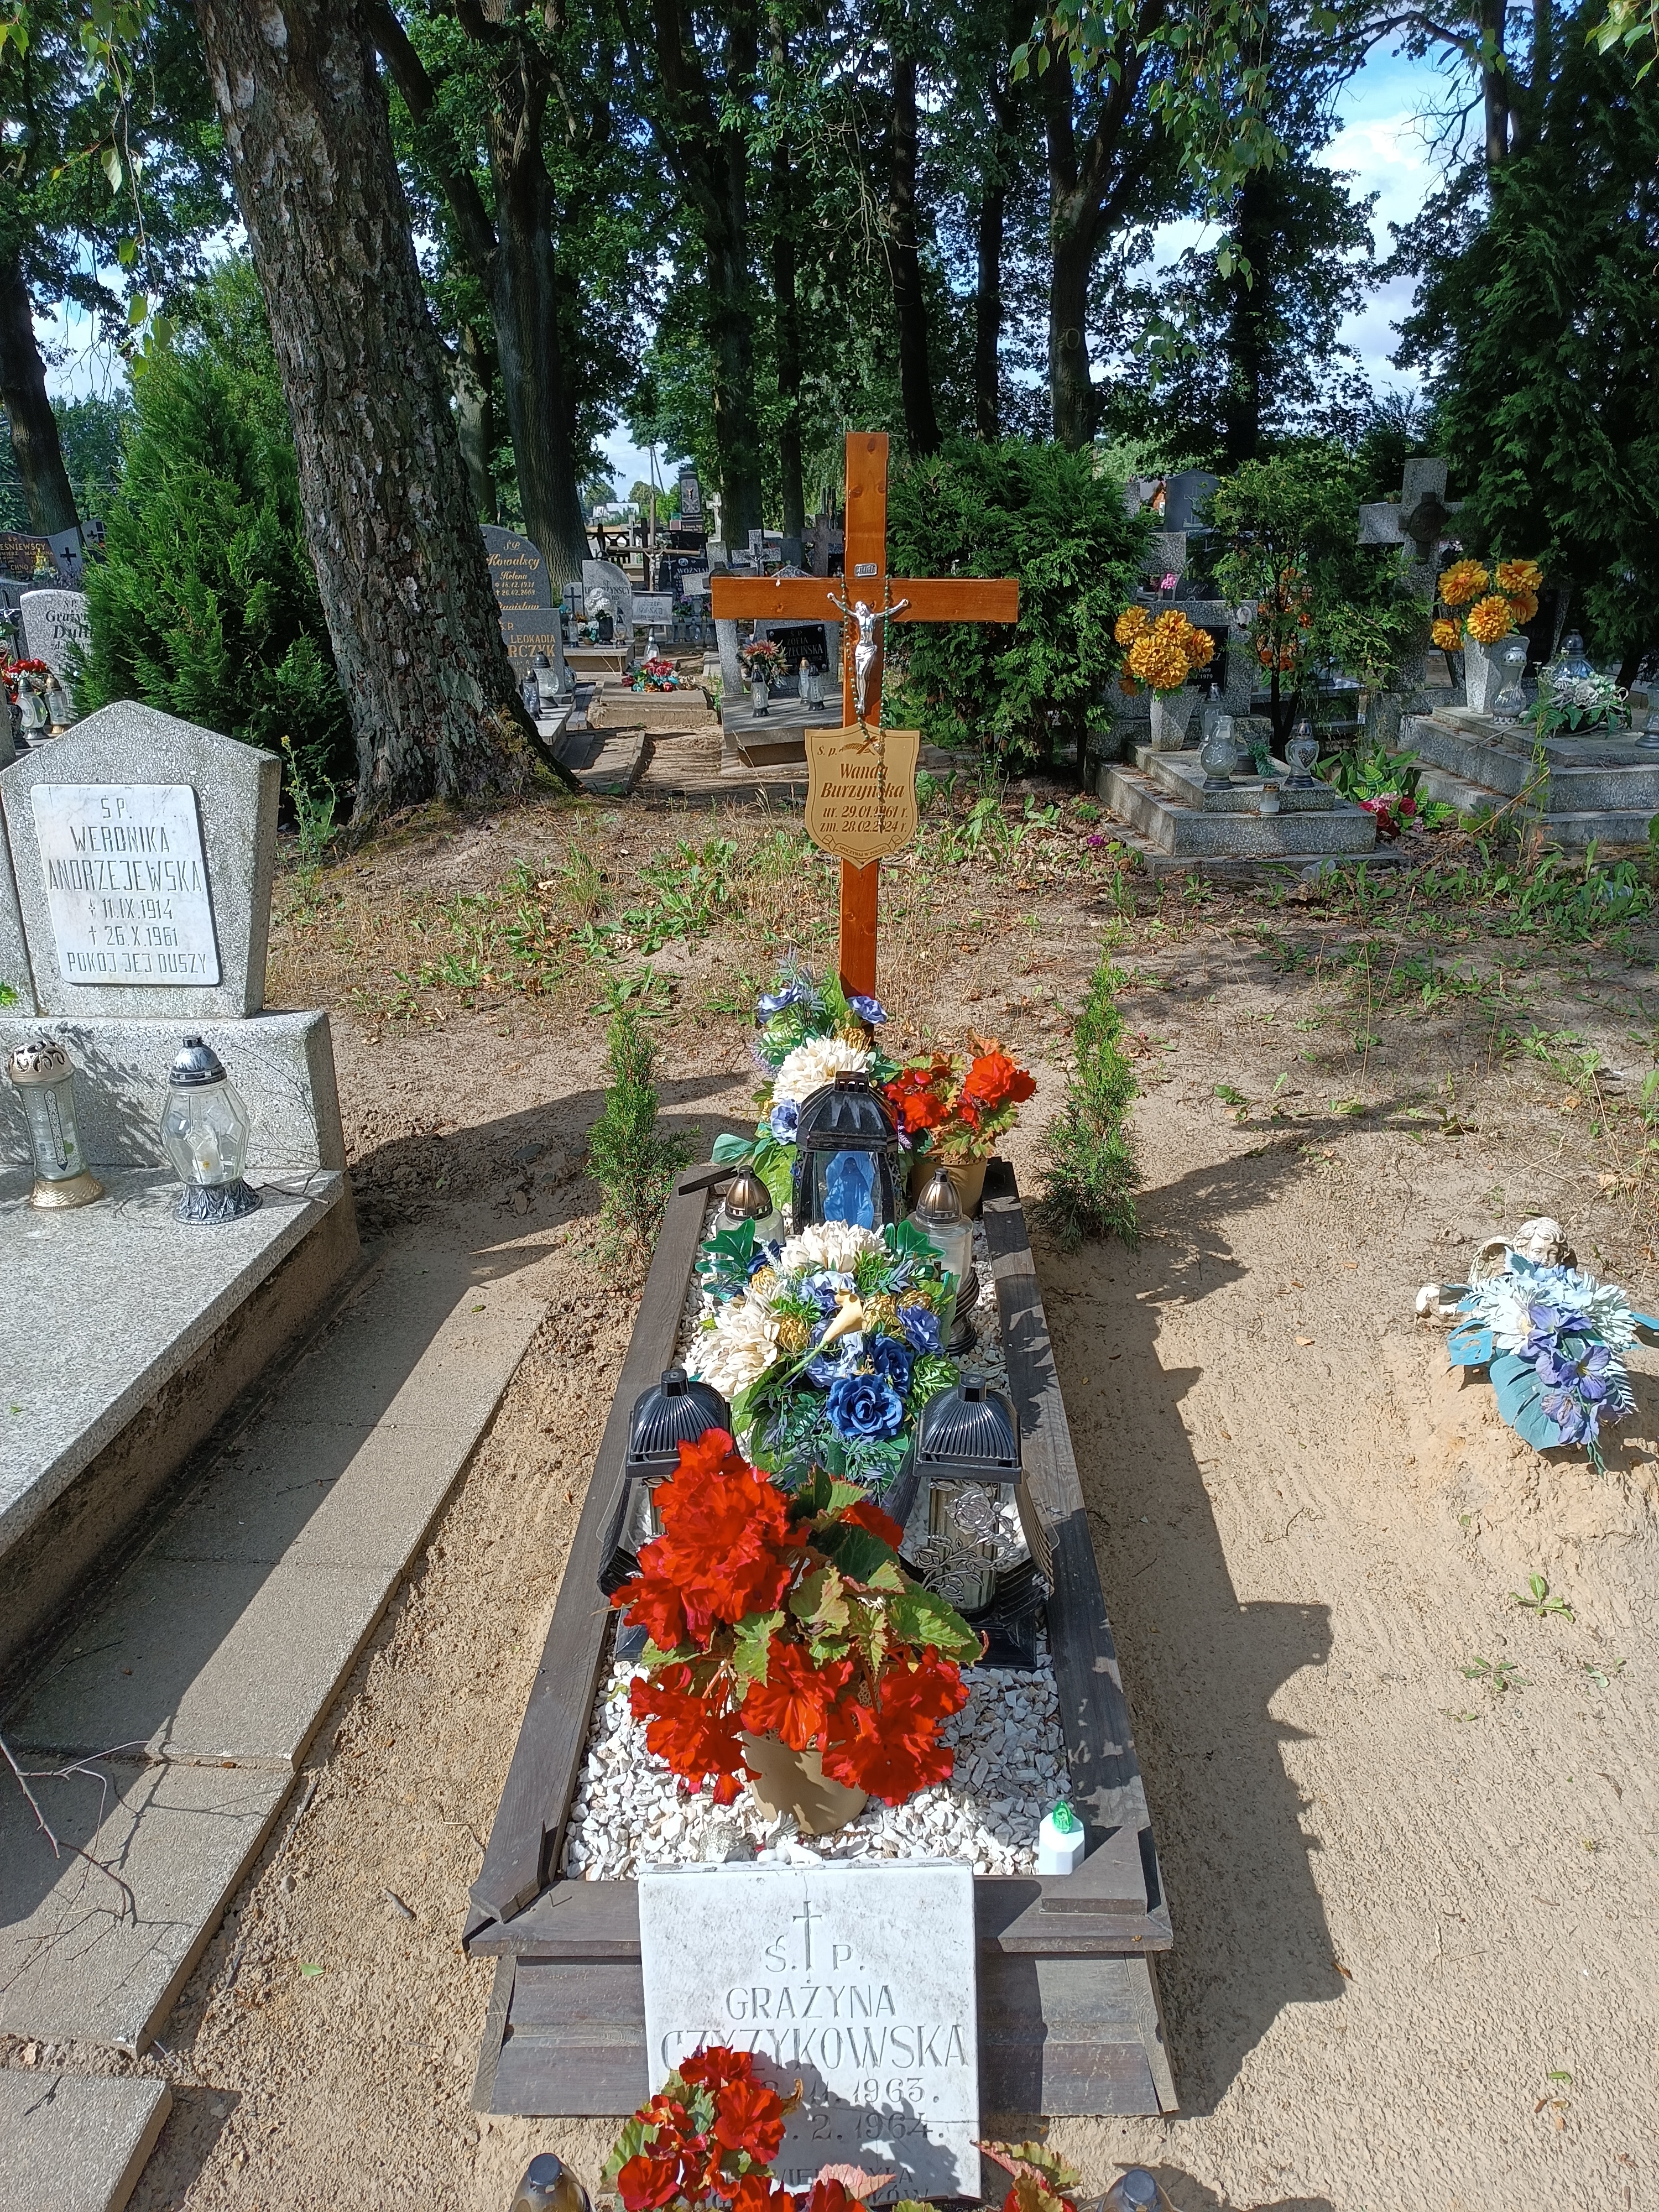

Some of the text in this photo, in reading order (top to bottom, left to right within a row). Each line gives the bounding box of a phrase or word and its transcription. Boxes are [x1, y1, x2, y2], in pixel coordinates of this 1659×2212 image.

[486, 554, 540, 570] Kowalscy
[510, 634, 556, 643] LEOKADIA
[787, 637, 808, 645] ZOFIA
[786, 644, 823, 658] ZECIŃSKA
[828, 748, 837, 757] p.
[841, 763, 889, 780] Wanda
[820, 782, 905, 801] Burzyńka
[823, 807, 837, 818] ur.
[900, 807, 908, 818] r.
[820, 821, 907, 833] zm. 28.02.224 r.
[70, 826, 170, 853] WERONIKA
[48, 859, 202, 891] ANDRZEJEWSKA
[102, 898, 173, 920] 11.IX.1914
[104, 926, 179, 947] 26.X.1961
[66, 951, 206, 974] POKÓJ JEJ DUSZY
[726, 1979, 896, 2021] GRAŻYNA
